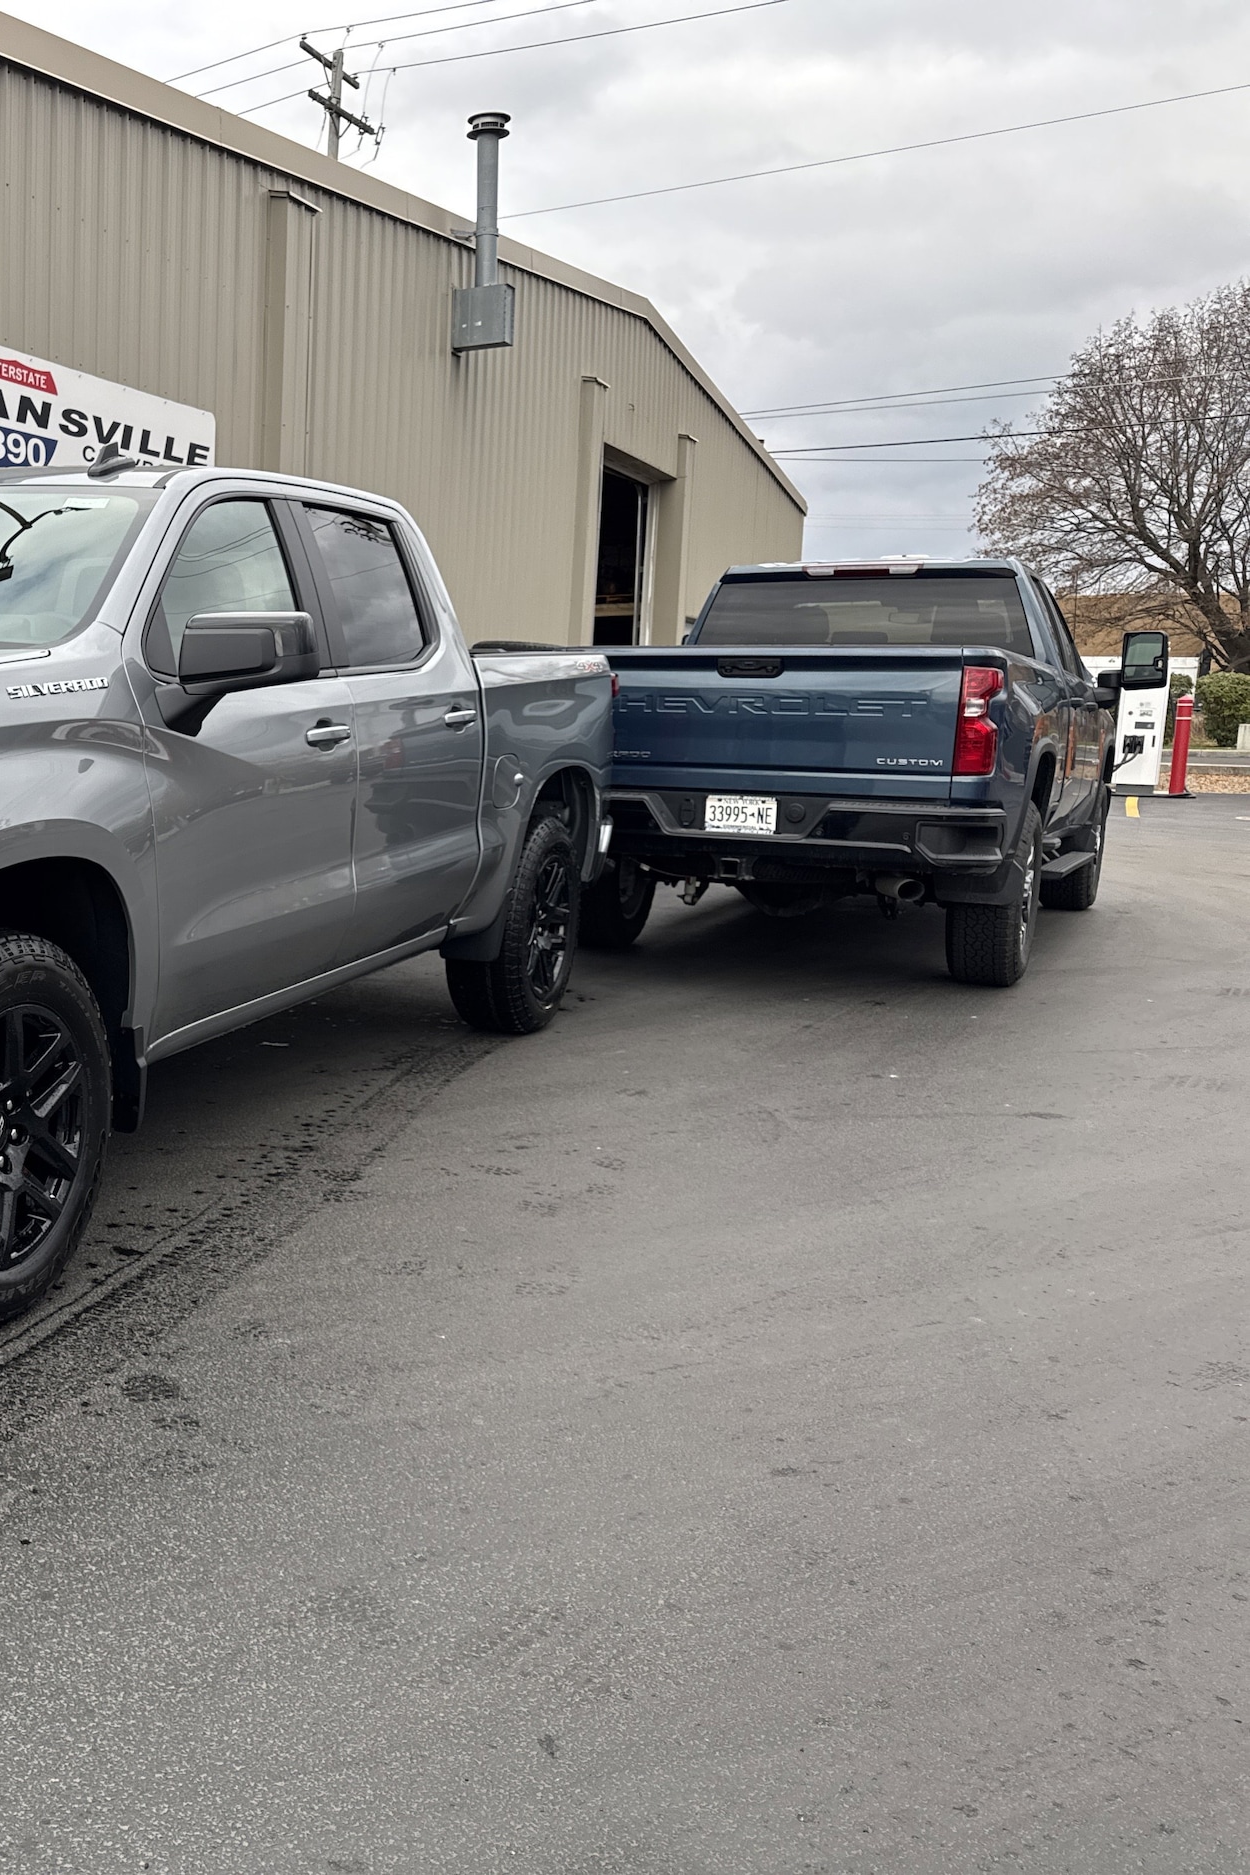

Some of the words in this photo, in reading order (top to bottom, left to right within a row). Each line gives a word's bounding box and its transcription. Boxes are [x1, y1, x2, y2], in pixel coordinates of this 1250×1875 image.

[6, 677, 109, 699] SILVERADO
[612, 693, 928, 718] HEVROLET
[876, 757, 944, 767] CUSTOM
